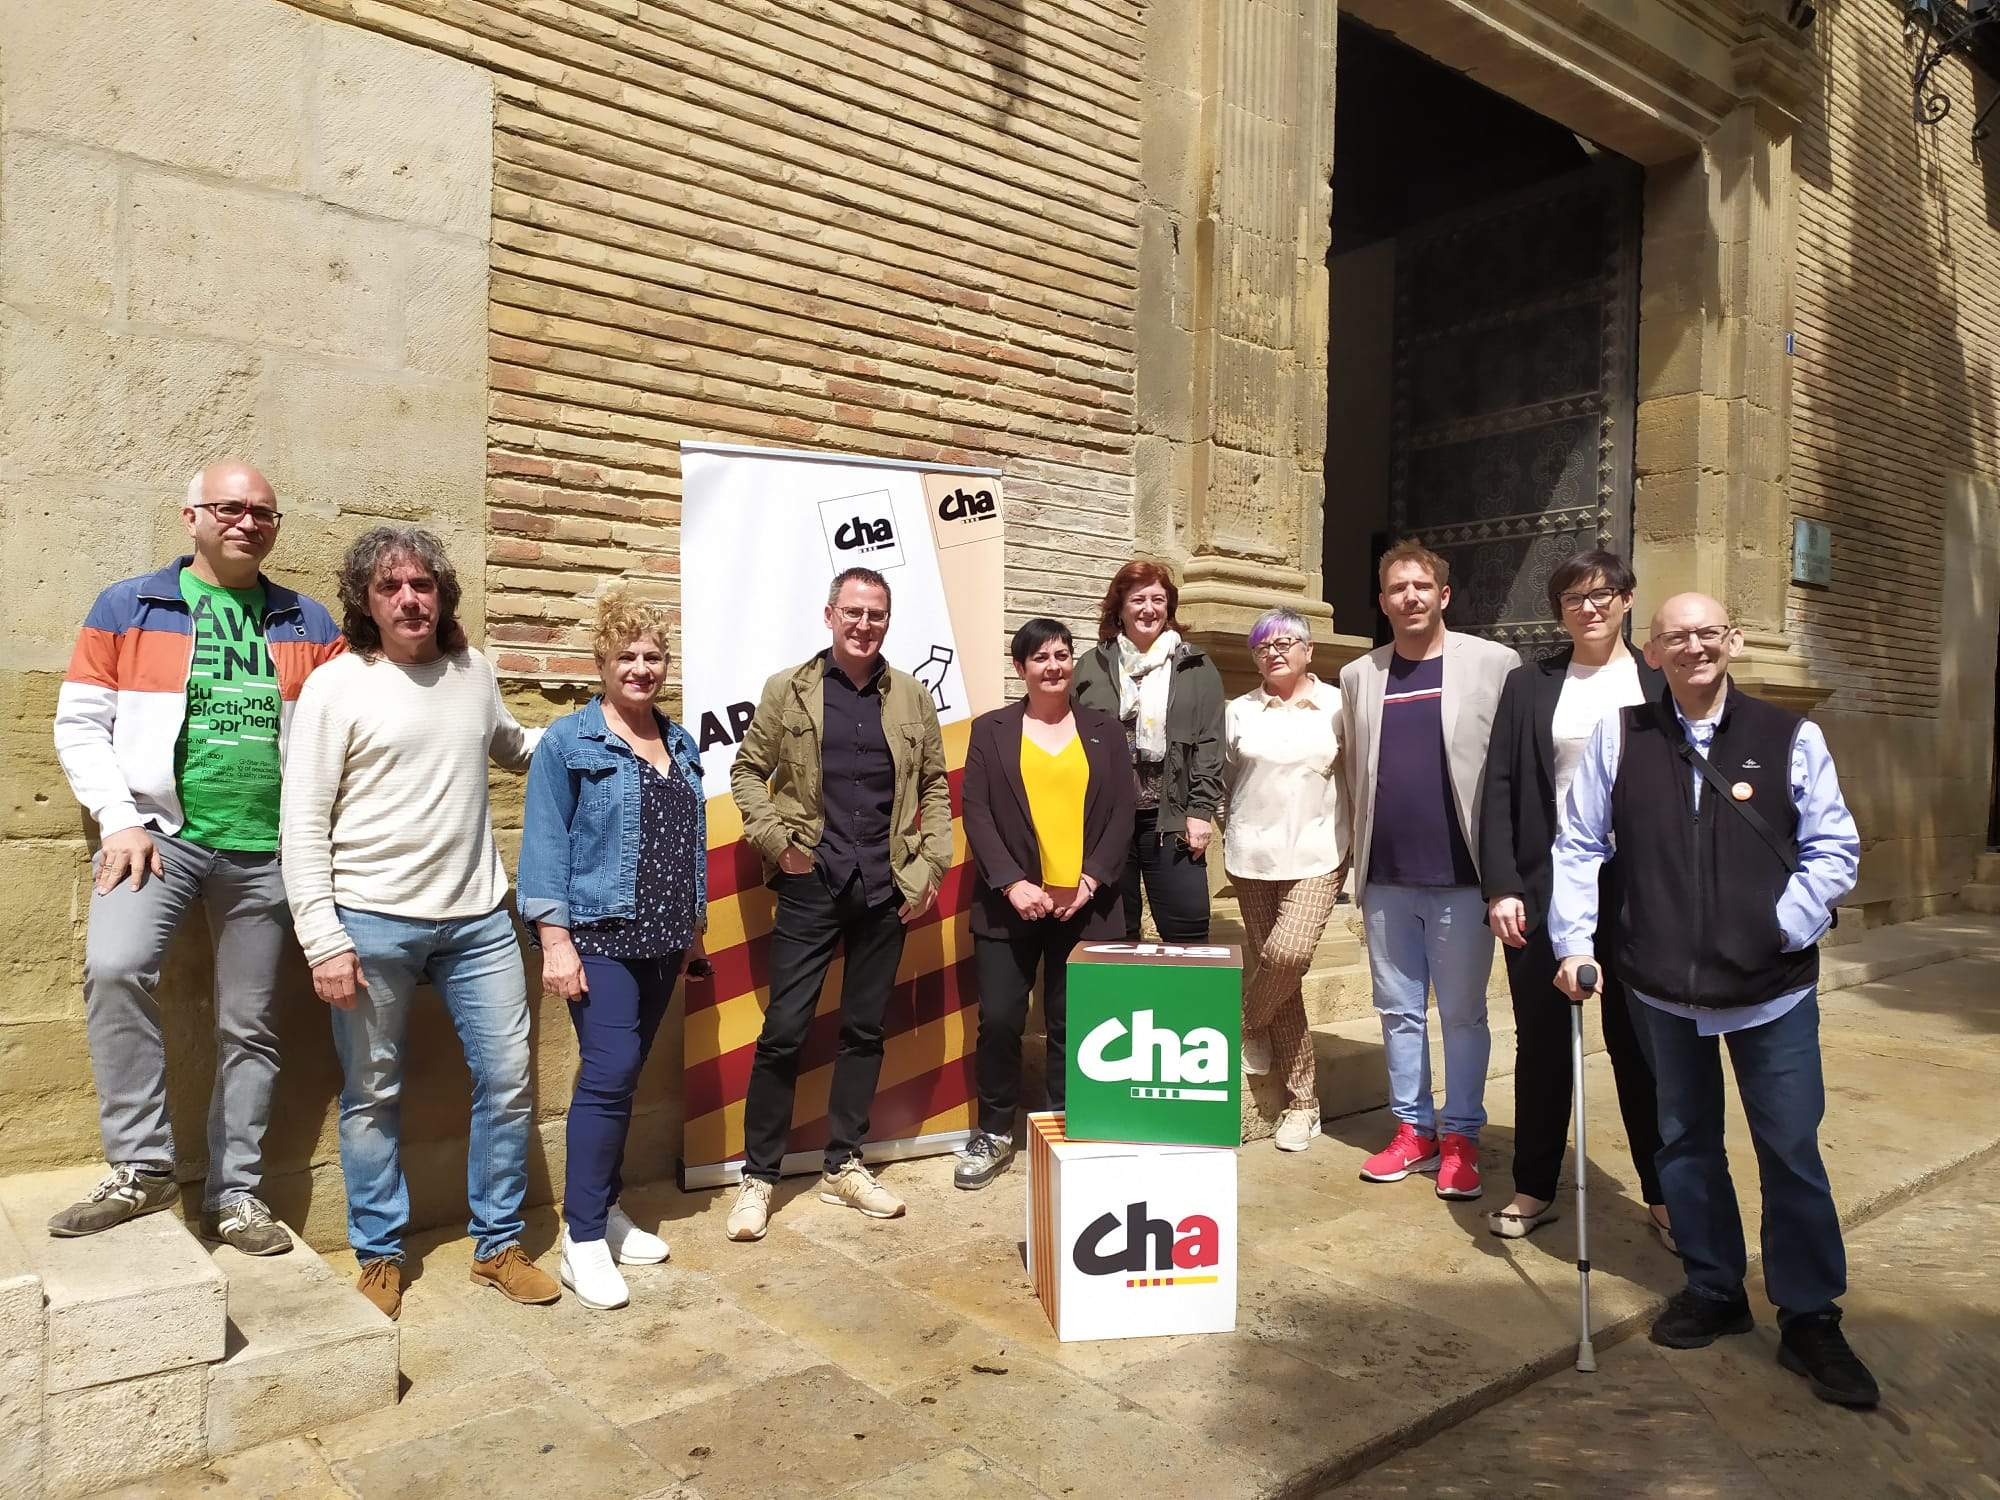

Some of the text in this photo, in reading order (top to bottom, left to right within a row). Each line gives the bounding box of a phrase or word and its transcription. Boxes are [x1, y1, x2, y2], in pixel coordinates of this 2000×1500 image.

[939, 488, 996, 522] cha
[834, 516, 894, 551] cha
[1077, 1008, 1229, 1083] cha
[1072, 1200, 1219, 1276] cha
